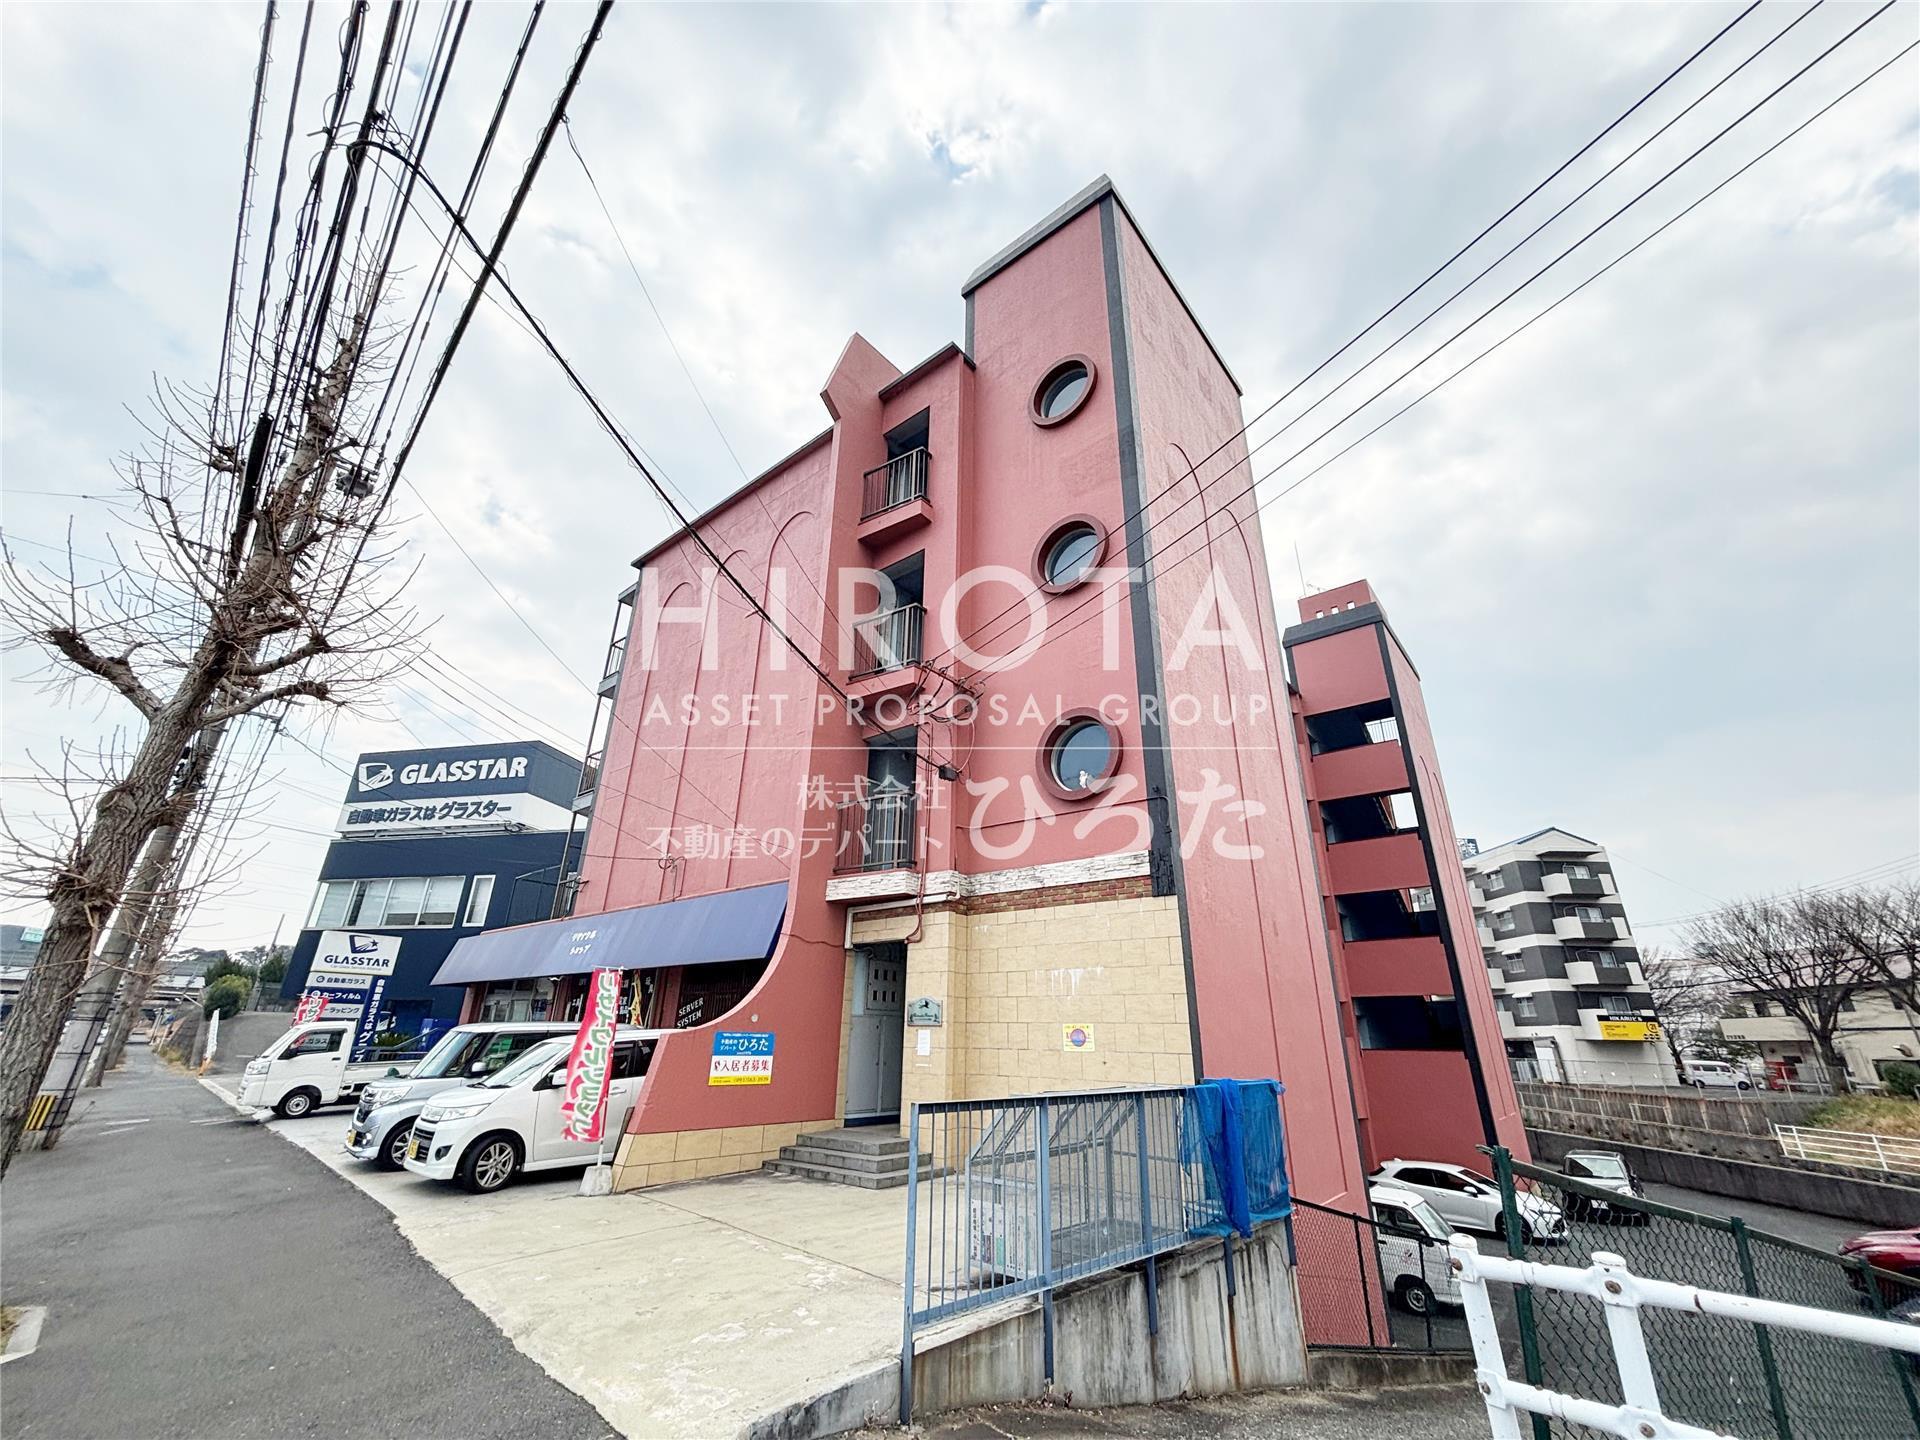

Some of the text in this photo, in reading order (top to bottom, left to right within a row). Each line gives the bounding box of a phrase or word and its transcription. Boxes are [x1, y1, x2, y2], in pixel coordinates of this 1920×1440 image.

[400, 757, 528, 785] GLASSTAR
[346, 800, 512, 825] 自動車ガラスはグラスター
[324, 955, 390, 968] GLASSTAR
[678, 997, 704, 1017] SERVER
[676, 1010, 702, 1029] SYSTEM
[738, 1038, 769, 1051] ひろた
[720, 1059, 769, 1072] 入居者募集
